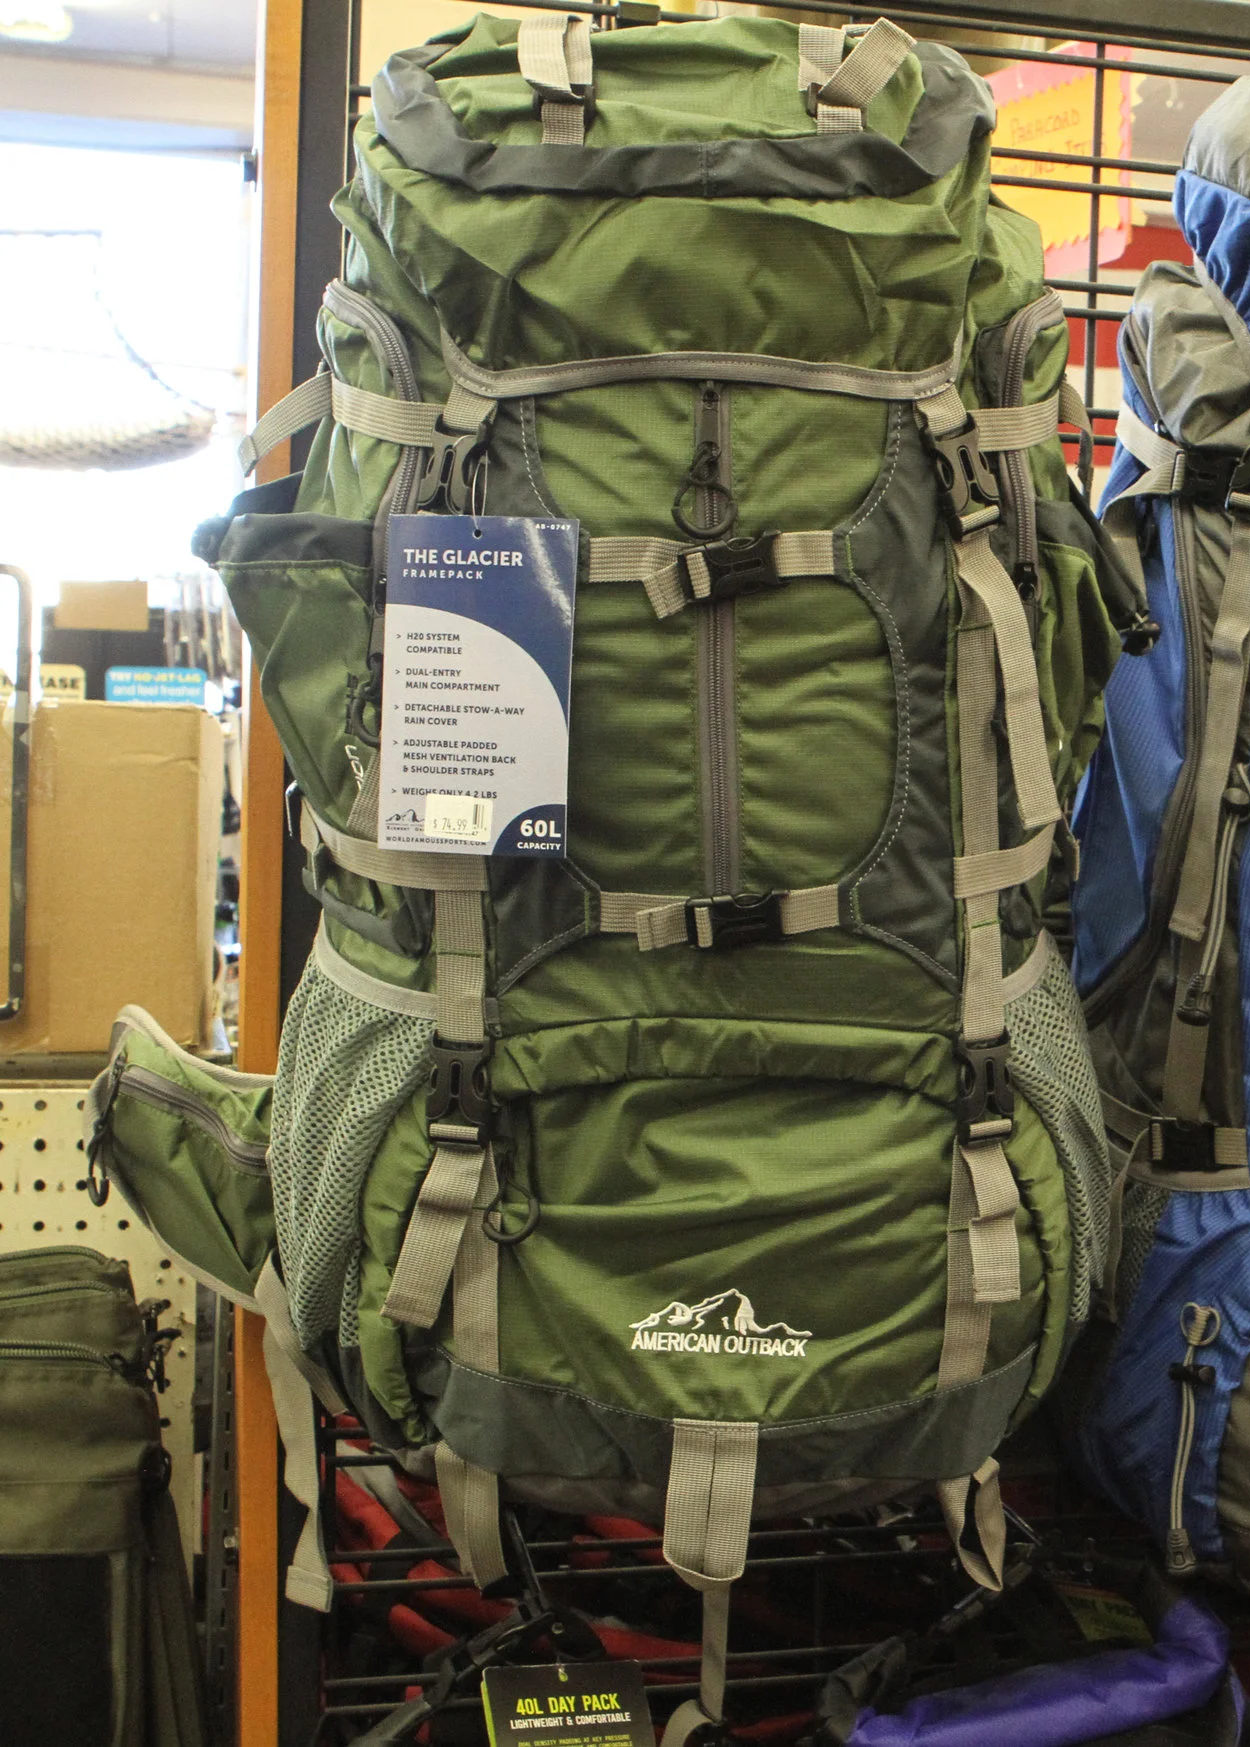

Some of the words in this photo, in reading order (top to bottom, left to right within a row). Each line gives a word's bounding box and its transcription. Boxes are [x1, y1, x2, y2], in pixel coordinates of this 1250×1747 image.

[403, 548, 438, 564] THE
[442, 550, 523, 567] GLACIER
[402, 568, 483, 580] FRAMEPACK
[426, 633, 460, 641] SYSTEM
[406, 645, 462, 655] COMPATIBLE
[405, 668, 462, 677] DUAL-ENTRY
[405, 681, 428, 689] MAIN
[430, 682, 501, 692] COMPARTMENT
[404, 703, 461, 713] DETACHABLE
[463, 706, 525, 715] STOW-A-WAY
[404, 716, 425, 725] RAIN
[427, 717, 458, 726] COVER
[403, 739, 459, 749] ADJUSTABLE
[461, 741, 498, 750] PADDED
[403, 752, 428, 760] MESH
[430, 753, 489, 763] VENTILATION
[491, 756, 516, 764] BACK
[402, 765, 408, 773] &
[410, 765, 458, 775] SHOULDER
[460, 767, 494, 776] STRAPS
[481, 791, 497, 799] LBS
[520, 819, 562, 838] 60L
[516, 841, 561, 851] CAPACITY
[631, 1331, 721, 1354] AMERICAN
[724, 1335, 809, 1357] OUTBACK
[516, 1698, 544, 1716] 40L
[547, 1695, 576, 1714] DAY
[581, 1693, 621, 1712] PACK
[510, 1716, 564, 1730] LIGHTWEIGHT
[565, 1715, 573, 1726] &
[575, 1712, 632, 1725] COMFORTABLE
